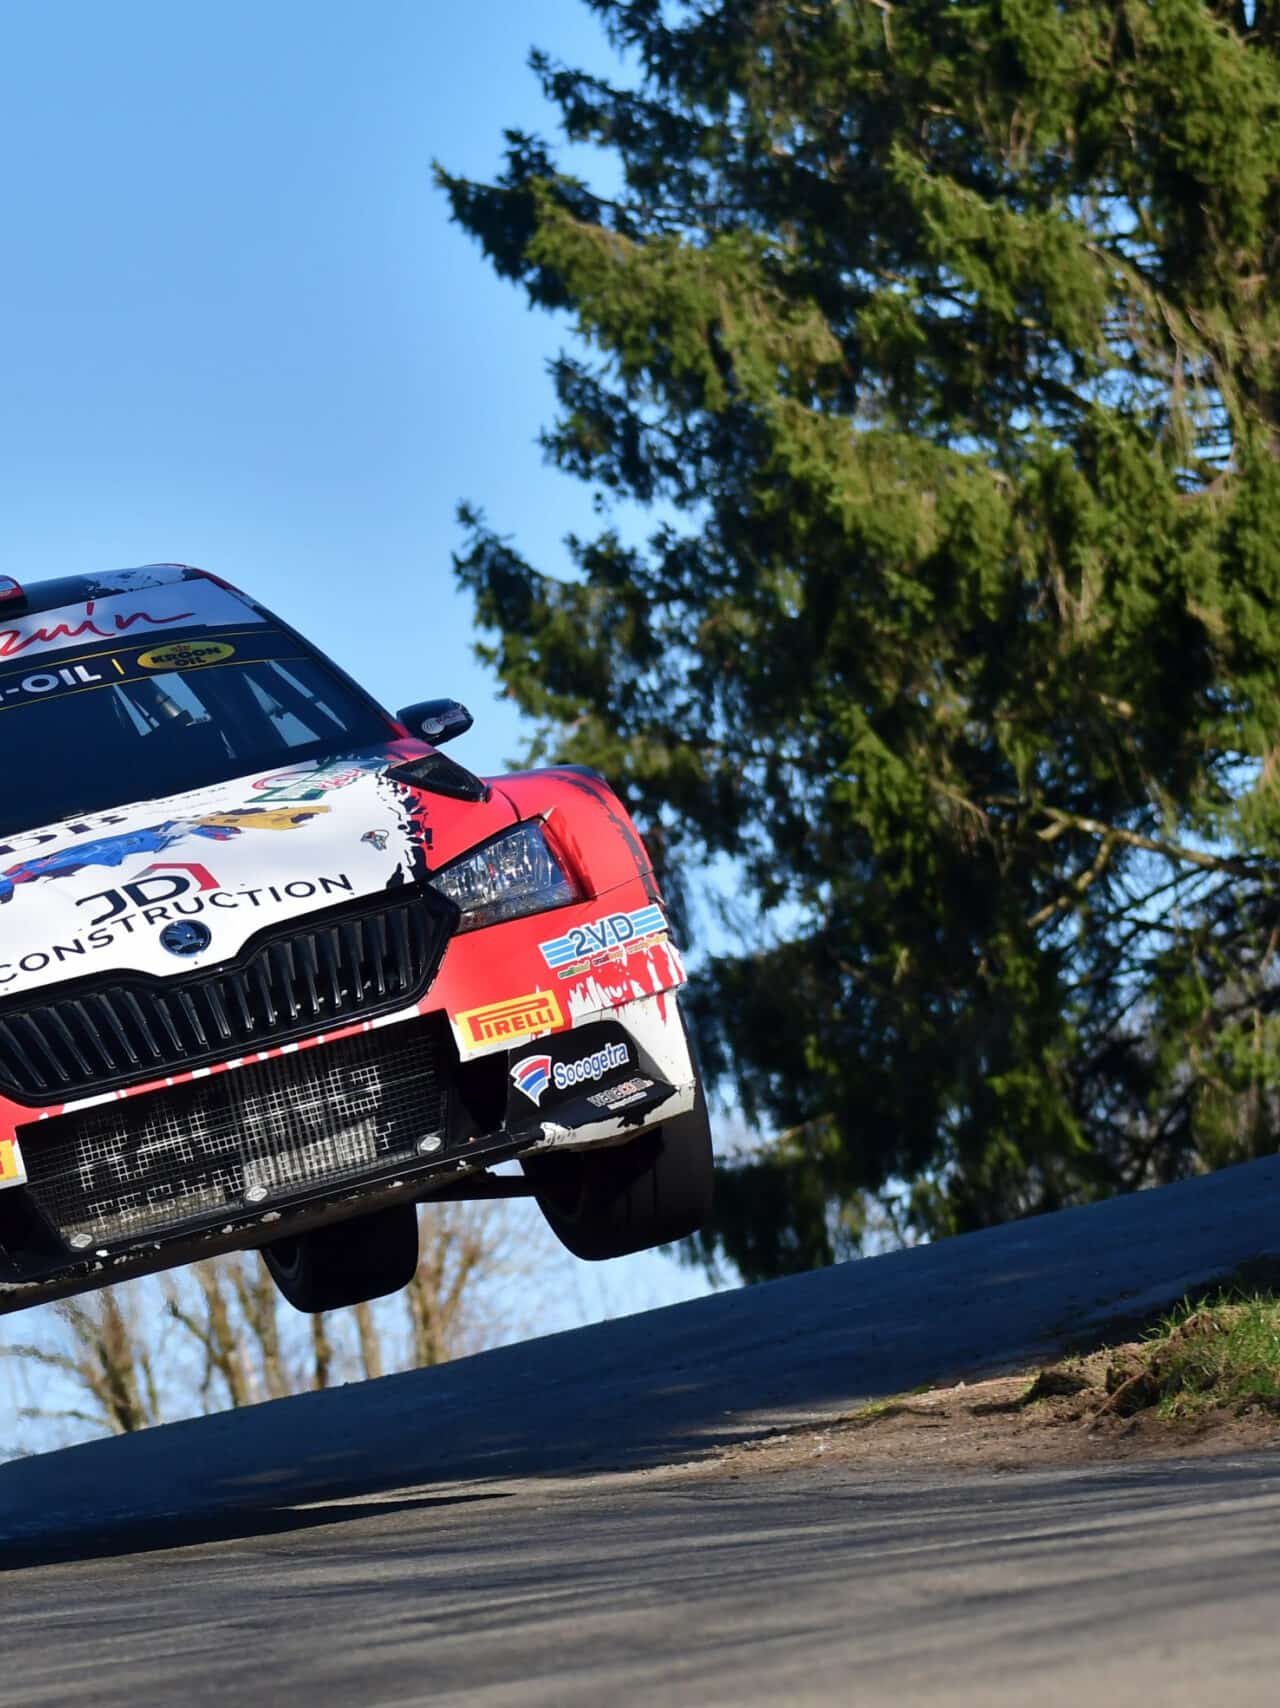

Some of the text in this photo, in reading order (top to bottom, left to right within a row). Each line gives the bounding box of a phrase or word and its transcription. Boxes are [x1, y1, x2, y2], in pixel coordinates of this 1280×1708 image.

[151, 646, 221, 664] KROON
[175, 655, 206, 667] OIL
[75, 875, 191, 926] JD
[569, 914, 635, 957] 2VD
[467, 996, 556, 1042] PIRELLI
[553, 1042, 630, 1090] Socogetra
